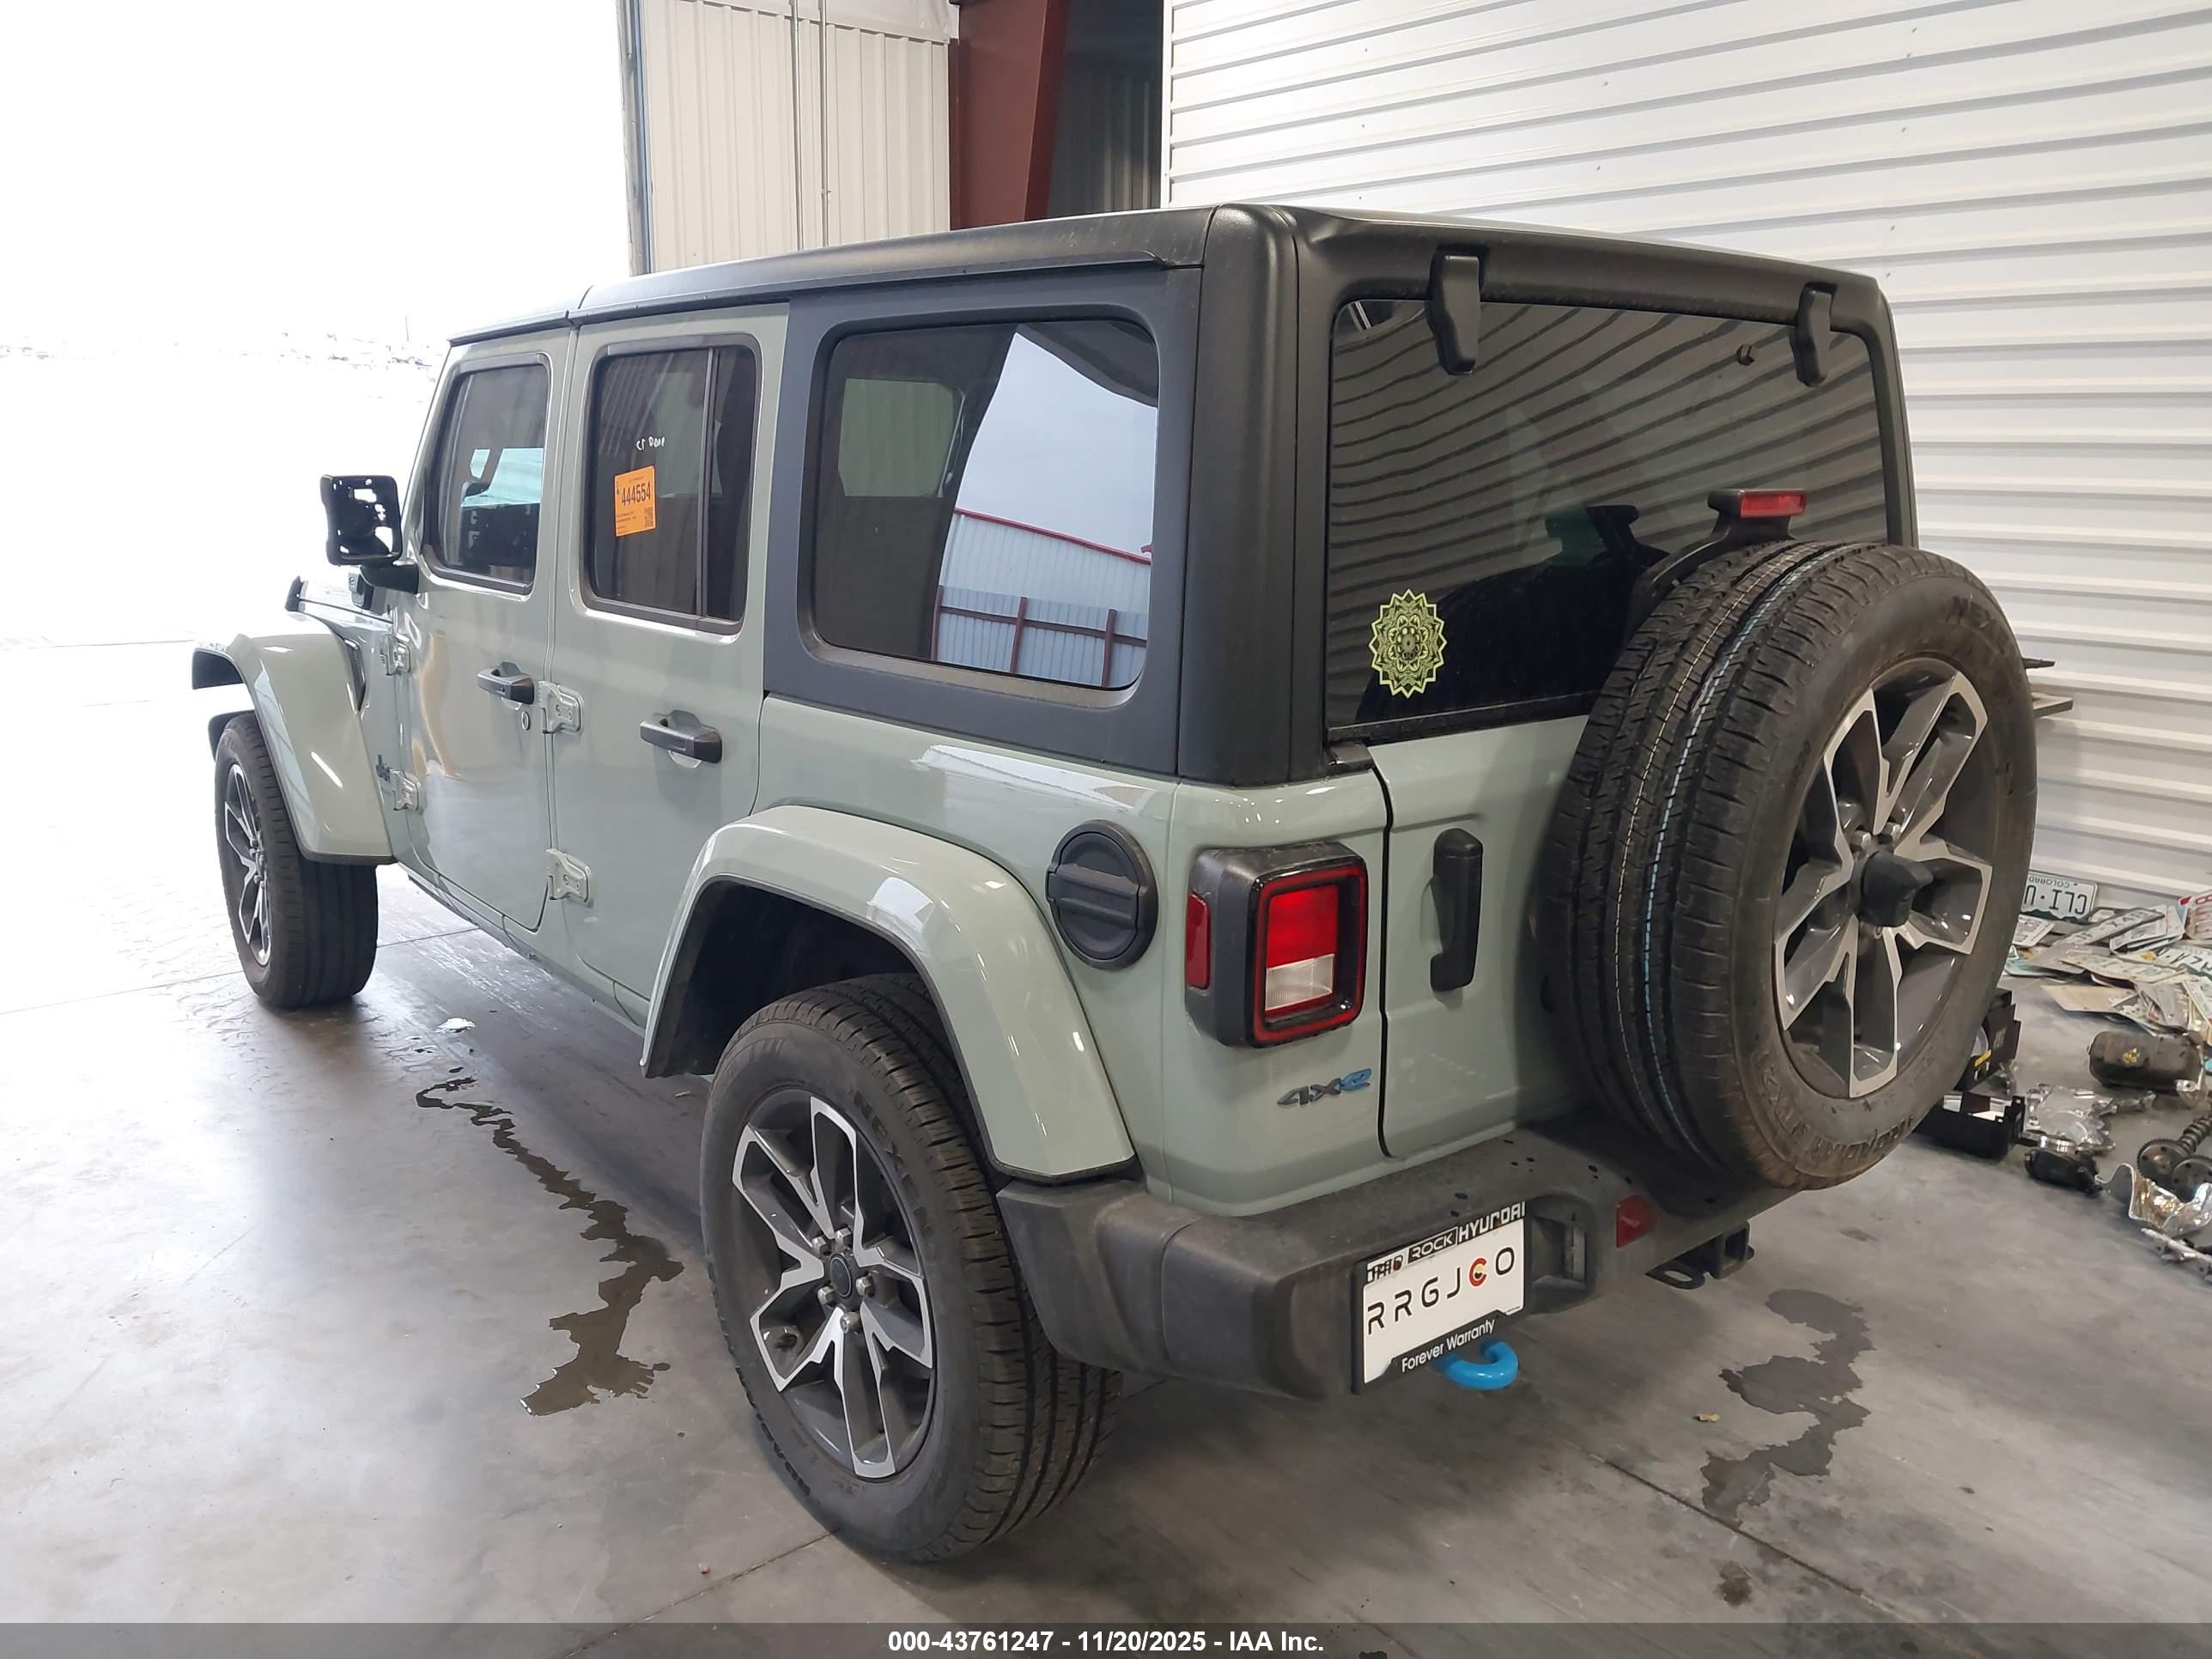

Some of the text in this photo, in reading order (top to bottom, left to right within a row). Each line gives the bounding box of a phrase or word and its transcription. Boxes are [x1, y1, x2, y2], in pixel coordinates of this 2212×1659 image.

[621, 481, 652, 506] 444554
[1458, 1201, 1526, 1243] HYUNDAI
[1401, 1319, 1496, 1374] Forever Warranty
